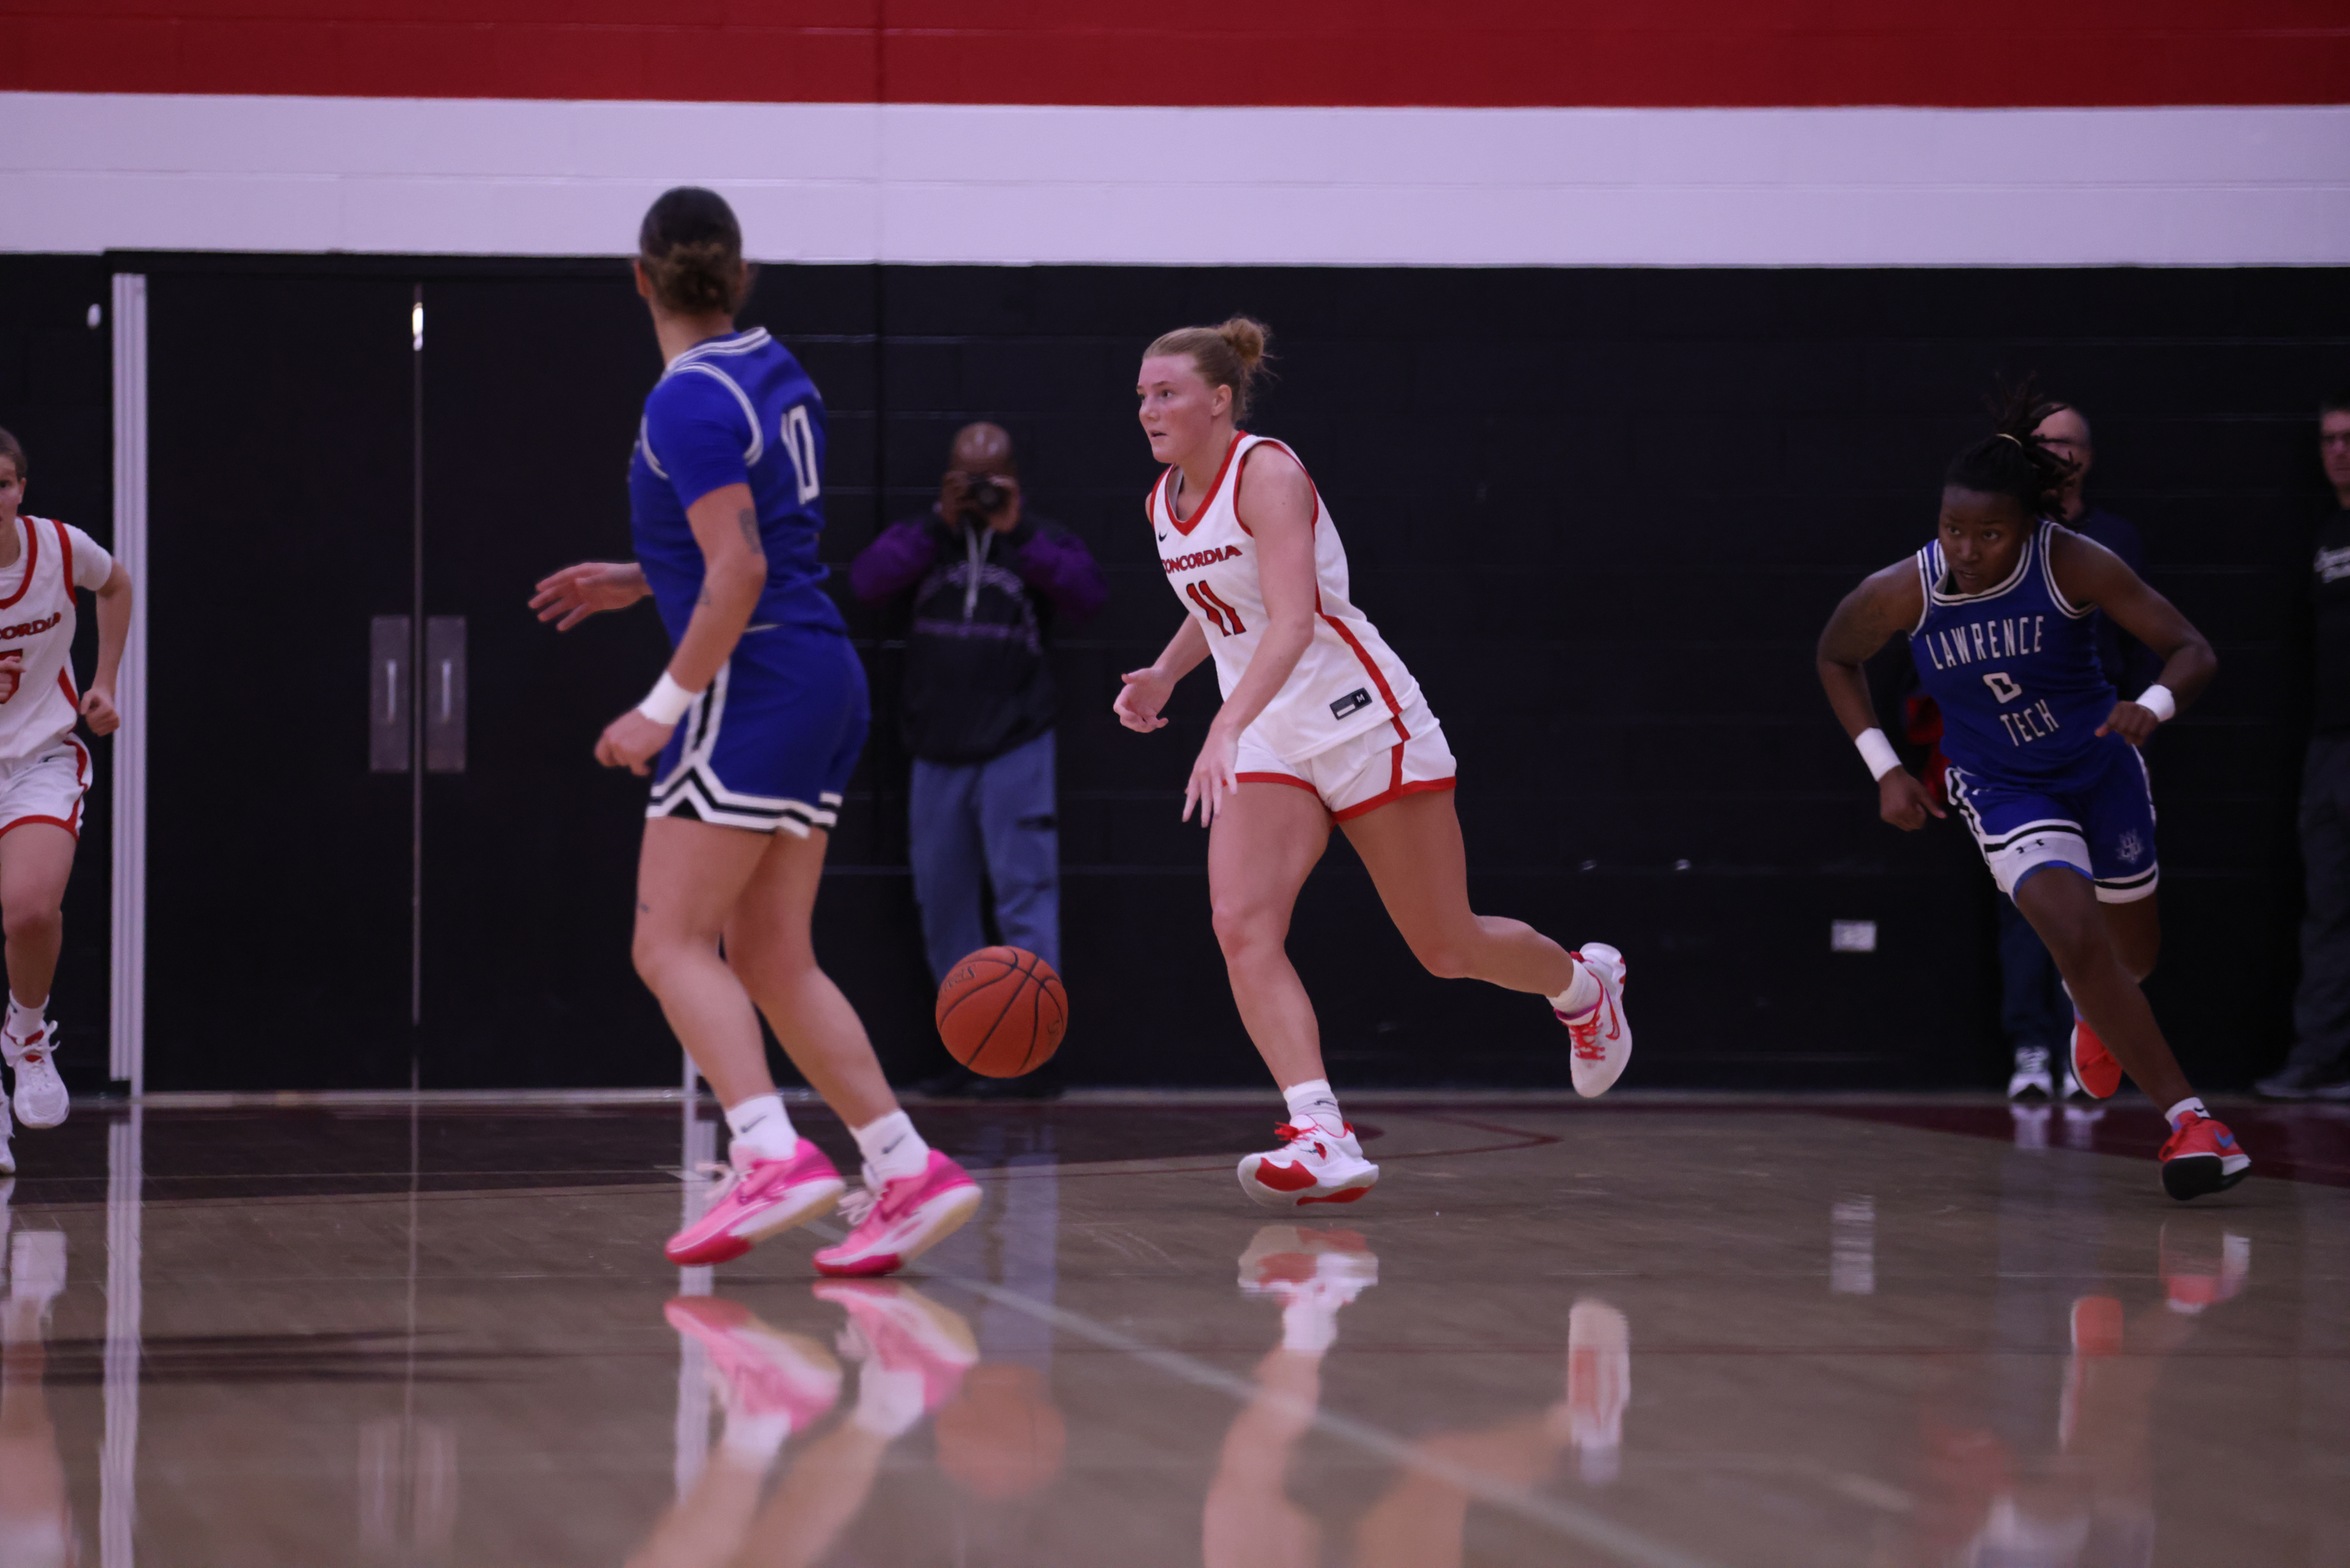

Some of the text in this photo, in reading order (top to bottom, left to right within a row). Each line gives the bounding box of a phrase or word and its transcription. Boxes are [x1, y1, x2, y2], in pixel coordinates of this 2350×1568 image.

[0, 612, 61, 640] ORDIA
[1186, 580, 1247, 637] 11
[1925, 615, 2044, 670] LAWRENCE
[1982, 672, 2022, 704] 0
[1999, 699, 2059, 747] TECH
